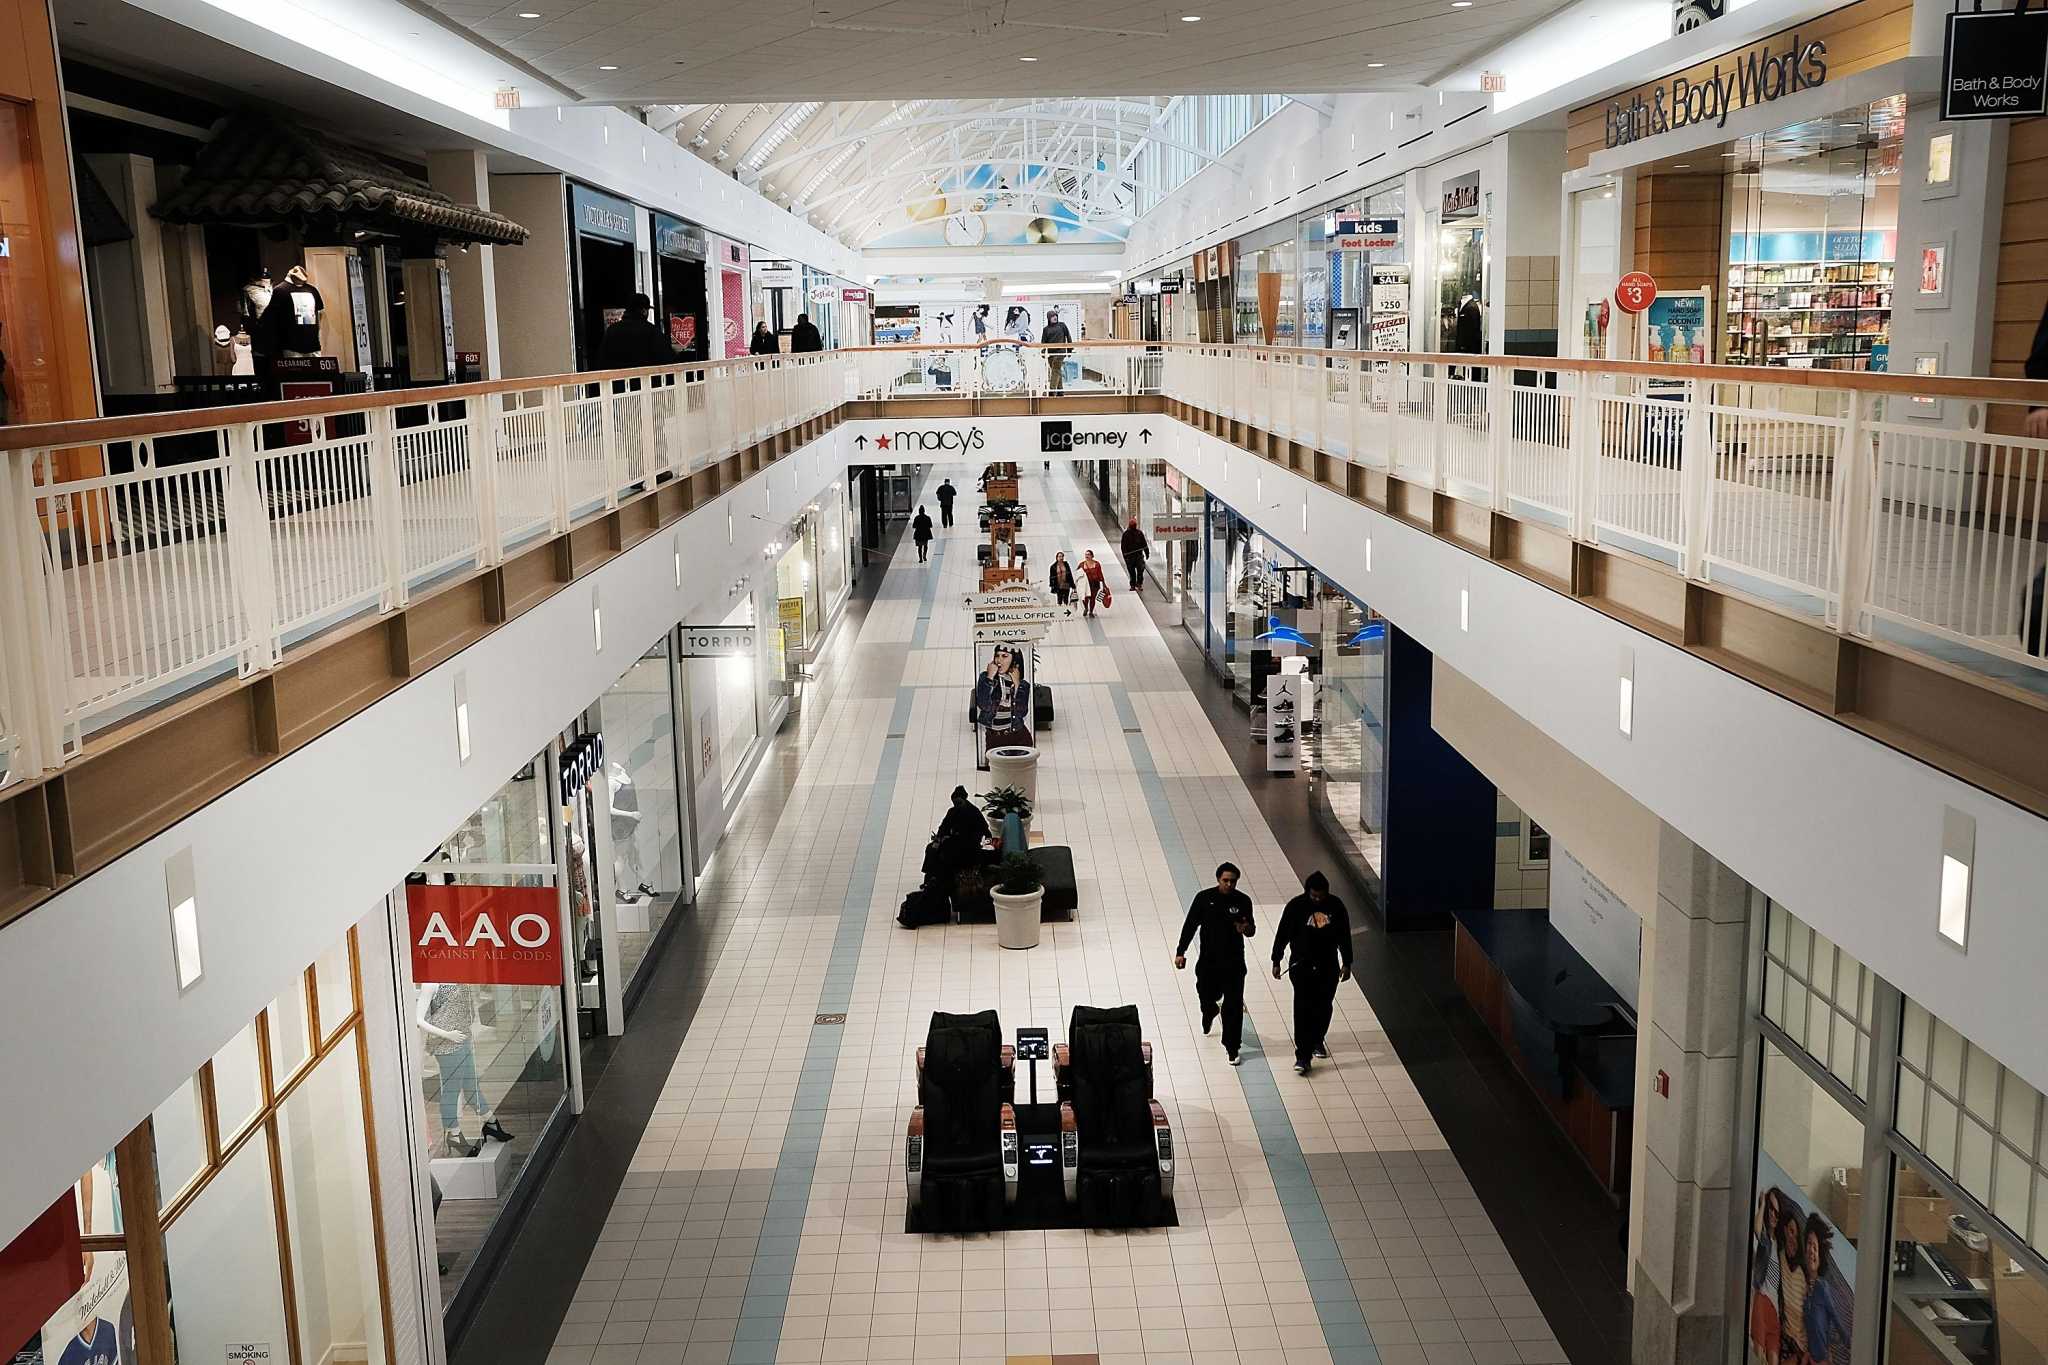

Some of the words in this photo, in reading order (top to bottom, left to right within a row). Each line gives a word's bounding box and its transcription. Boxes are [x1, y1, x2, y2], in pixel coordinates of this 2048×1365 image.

[1485, 76, 1504, 90] EXIT
[1953, 78, 1987, 91] Bath
[1989, 76, 2000, 89] &
[2002, 75, 2041, 90] Body
[1606, 94, 1650, 150] Bath
[1652, 86, 1669, 135] &
[1672, 64, 1736, 129] Body
[1737, 34, 1827, 109] Works
[496, 92, 518, 107] EXIT
[1973, 93, 2019, 107] Works
[1354, 222, 1383, 233] kids
[1341, 239, 1361, 247] Foot
[1364, 238, 1395, 247] Locker
[1379, 276, 1404, 284] SALE
[1627, 287, 1642, 303] $3
[1380, 300, 1401, 310] $250
[1675, 300, 1695, 308] NEW!
[676, 331, 690, 339] FREE
[894, 427, 985, 456] macy's
[1045, 431, 1128, 450] jcpenney
[984, 596, 1031, 605] JCPENNEY
[998, 613, 1022, 621] MALL
[993, 629, 1026, 637] MACY'S
[688, 637, 752, 648] TORRID
[563, 732, 604, 806] TORRID
[418, 911, 551, 948] AAO
[419, 949, 477, 960] AGAINST
[483, 951, 507, 960] ALL
[512, 951, 553, 961] ODDS
[228, 1351, 269, 1359] SMOKING
